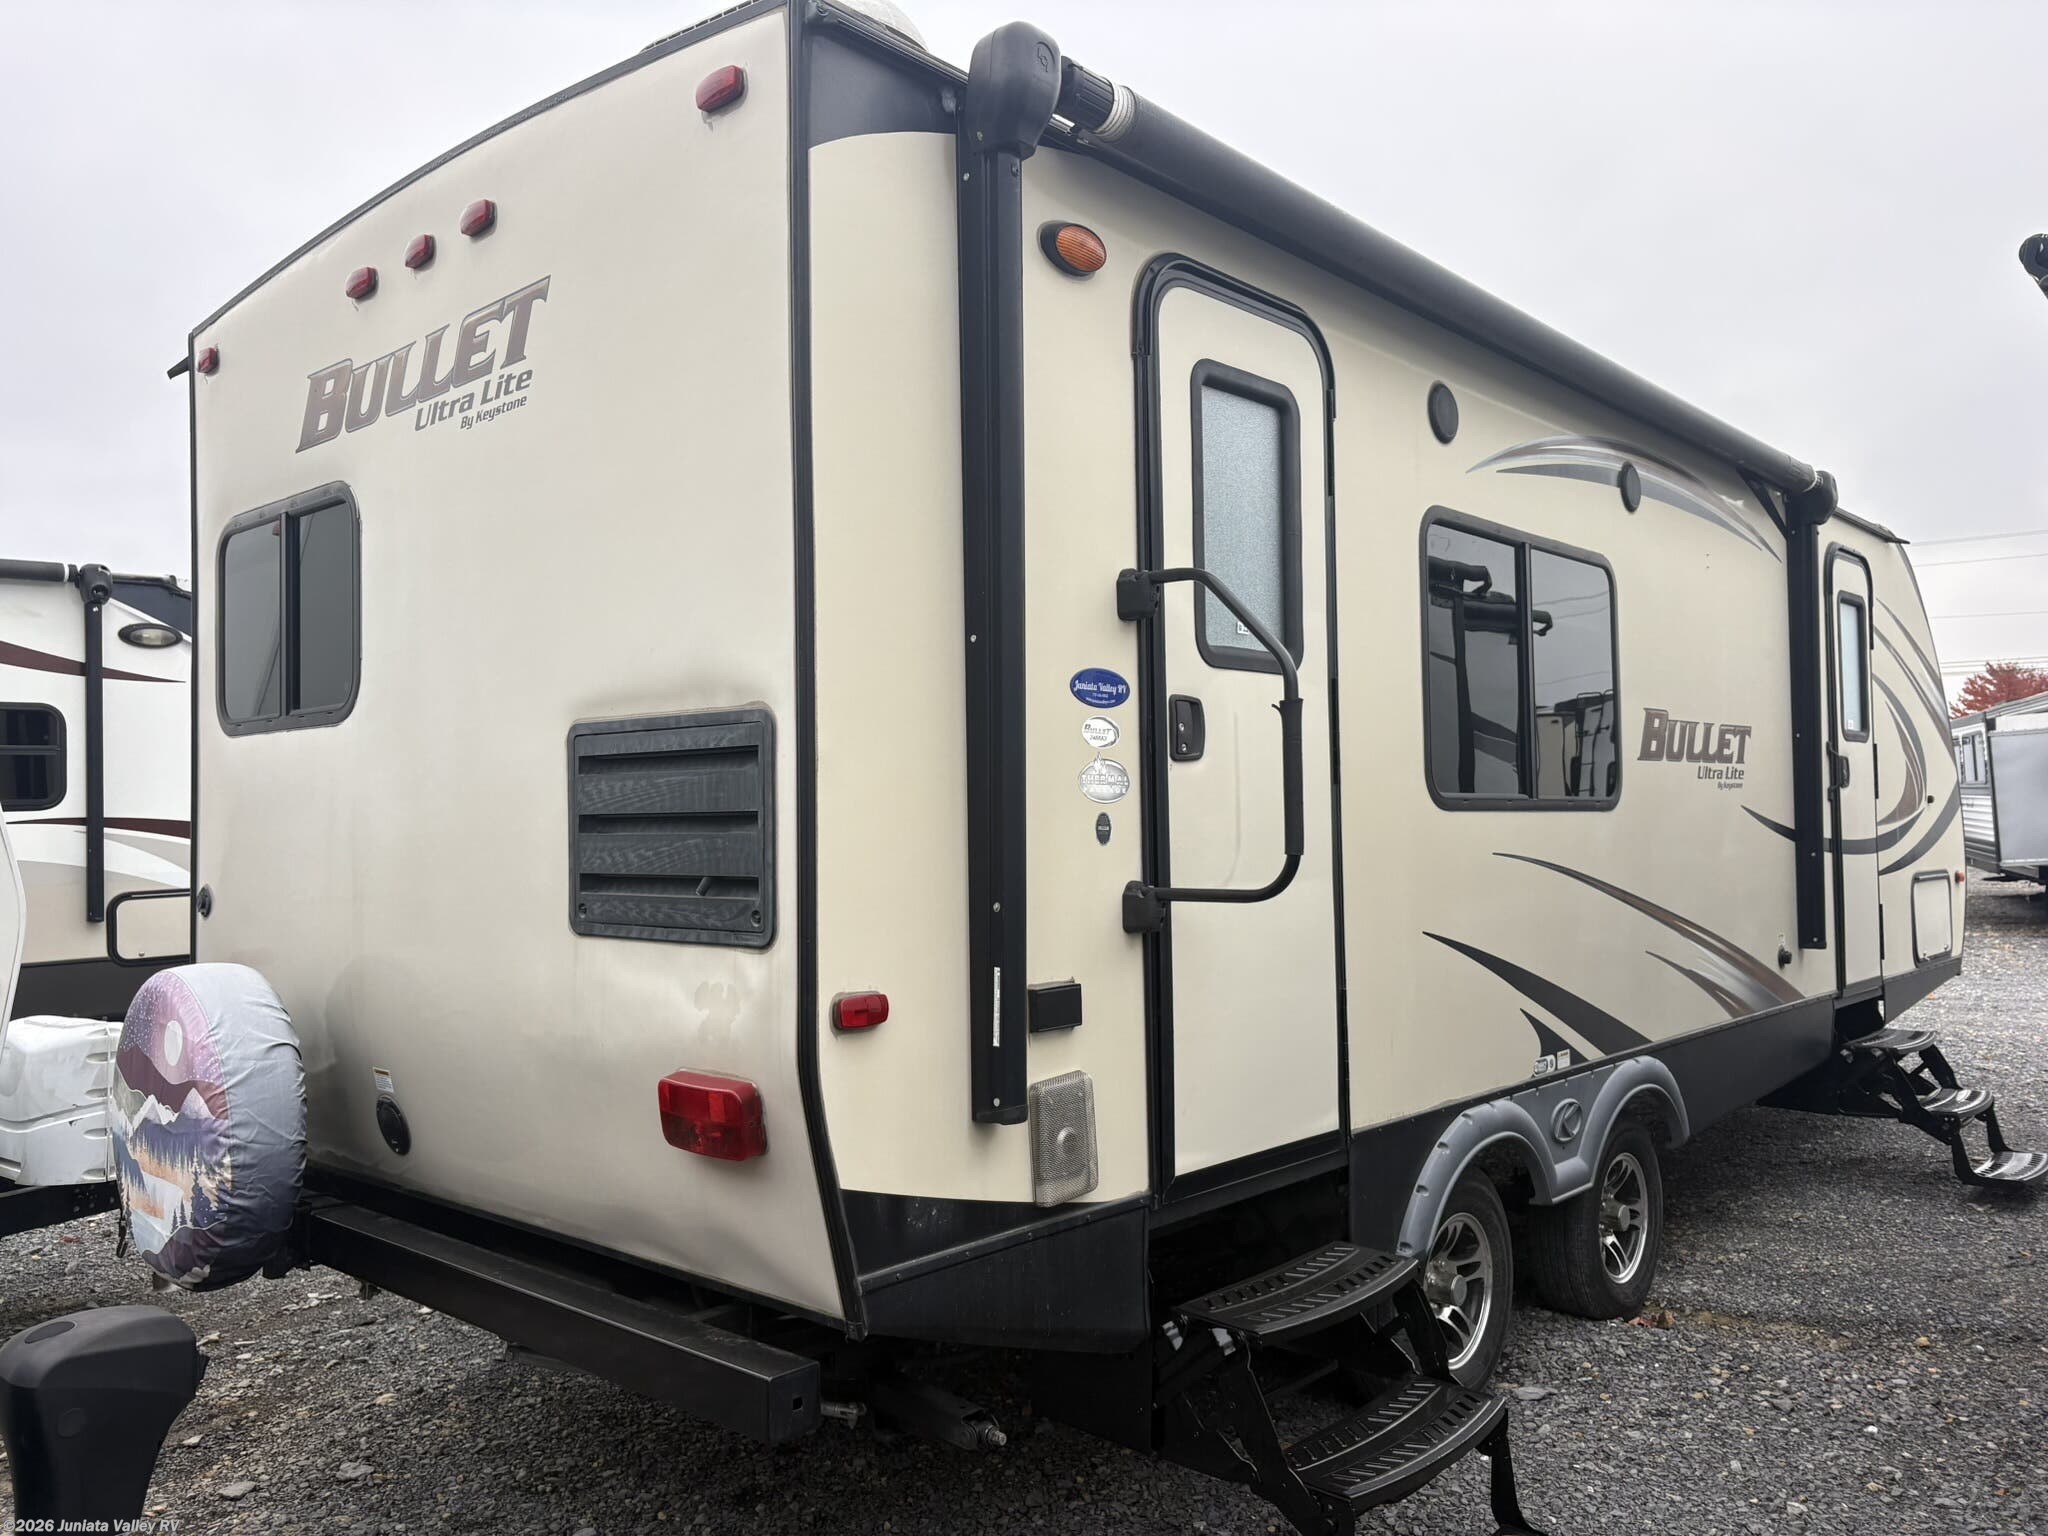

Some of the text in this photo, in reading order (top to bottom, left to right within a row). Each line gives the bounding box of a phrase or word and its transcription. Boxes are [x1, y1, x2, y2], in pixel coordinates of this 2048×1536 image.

[295, 274, 551, 454] BULLET
[415, 369, 533, 431] Ultra Lite
[460, 395, 528, 430] By Keystone
[1098, 682, 1118, 696] Valley
[1117, 684, 1128, 695] RV
[1637, 707, 1752, 765] BULLET
[1697, 765, 1745, 780] Ultra Lite
